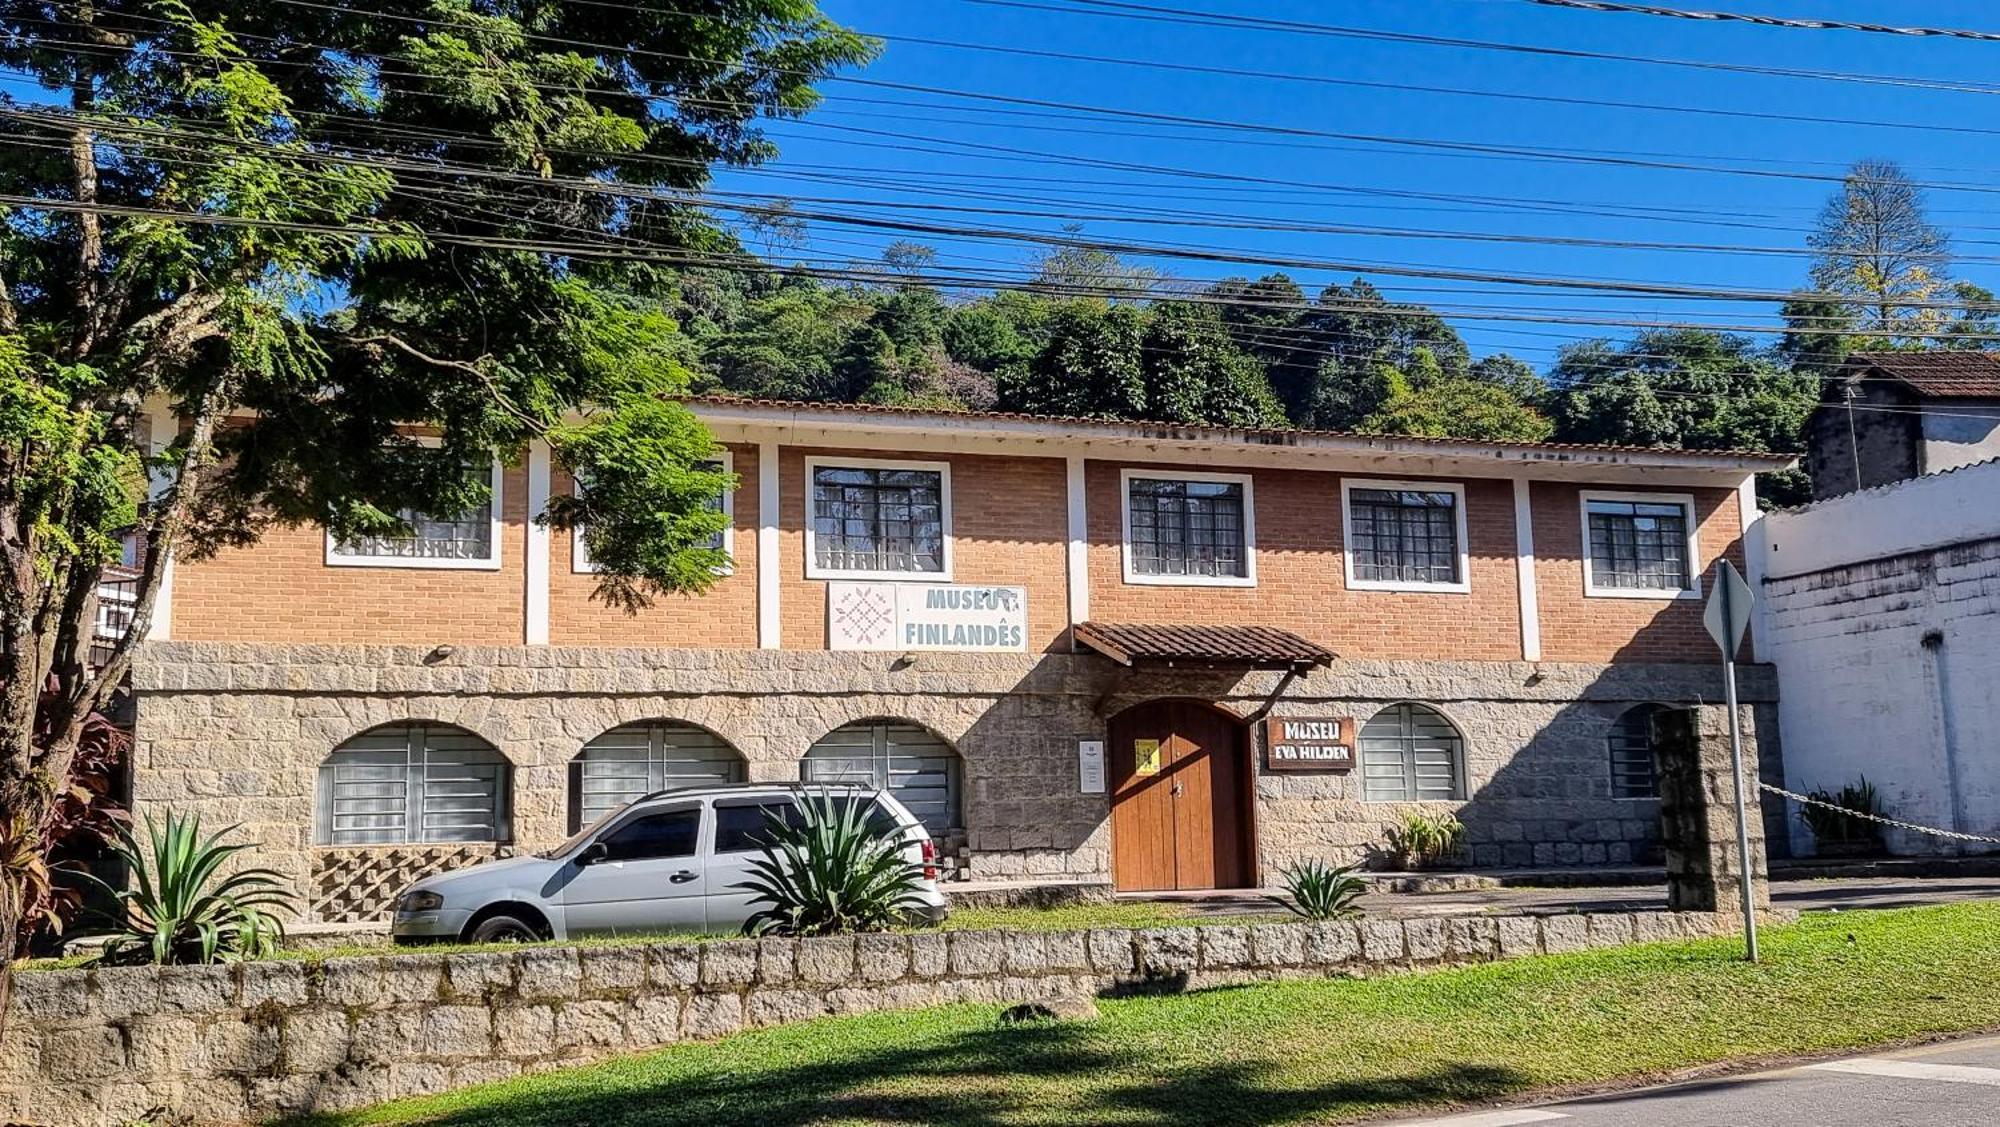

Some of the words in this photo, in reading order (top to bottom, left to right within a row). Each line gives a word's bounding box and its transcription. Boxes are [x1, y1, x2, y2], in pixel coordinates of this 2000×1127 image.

[926, 588, 1000, 610] MUSEU
[905, 617, 1021, 647] FINLANDÊS
[1284, 722, 1340, 740] MUSEU
[1275, 745, 1298, 760] EVA
